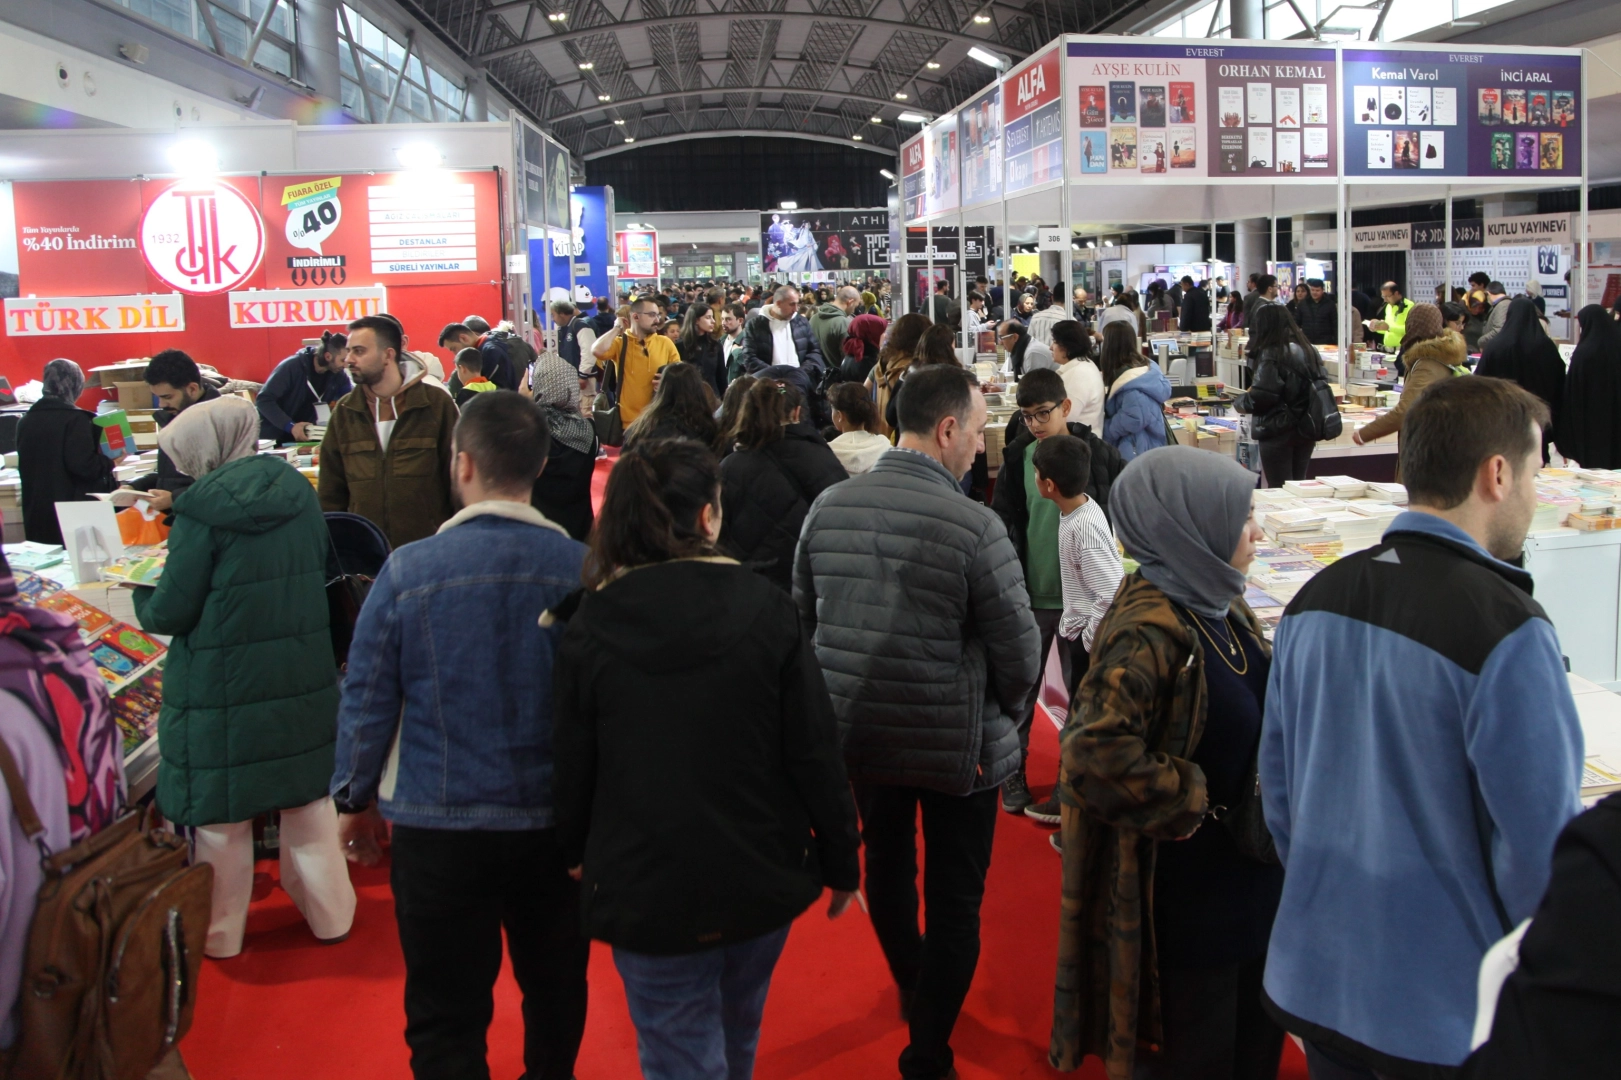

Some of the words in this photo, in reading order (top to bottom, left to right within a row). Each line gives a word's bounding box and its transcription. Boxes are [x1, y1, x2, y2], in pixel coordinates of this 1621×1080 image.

[1186, 48, 1224, 58] EVEREST
[1449, 54, 1484, 63] EVEREST
[1092, 63, 1129, 78] AYŞE
[1134, 62, 1181, 76] KULİN
[1219, 64, 1271, 77] ORHAN
[1275, 65, 1326, 79] KEMAL
[1371, 67, 1407, 80] Kemal
[1410, 68, 1439, 80] Varol
[1501, 69, 1523, 82] İNCİ
[1525, 72, 1553, 83] ARAL
[1017, 64, 1046, 106] ALFA
[909, 143, 922, 167] ALFA
[287, 187, 313, 199] FUARA
[315, 181, 333, 192] ÖZEL
[22, 226, 39, 234] Tüm
[40, 226, 80, 234] Yayınlarda
[1488, 223, 1517, 236] KUTLU
[23, 236, 63, 252] %40
[66, 233, 138, 250] İndirim
[151, 233, 180, 244] 1932
[399, 238, 447, 246] DESTANLAR
[1355, 231, 1376, 242] KUTLU
[555, 241, 583, 255] KİTAP
[292, 256, 341, 268] İNDİRİMLİ
[389, 262, 418, 271] SÜRELİ
[10, 302, 111, 333] TÜRK
[117, 299, 178, 329] DİL
[234, 298, 380, 324] KURUMU
